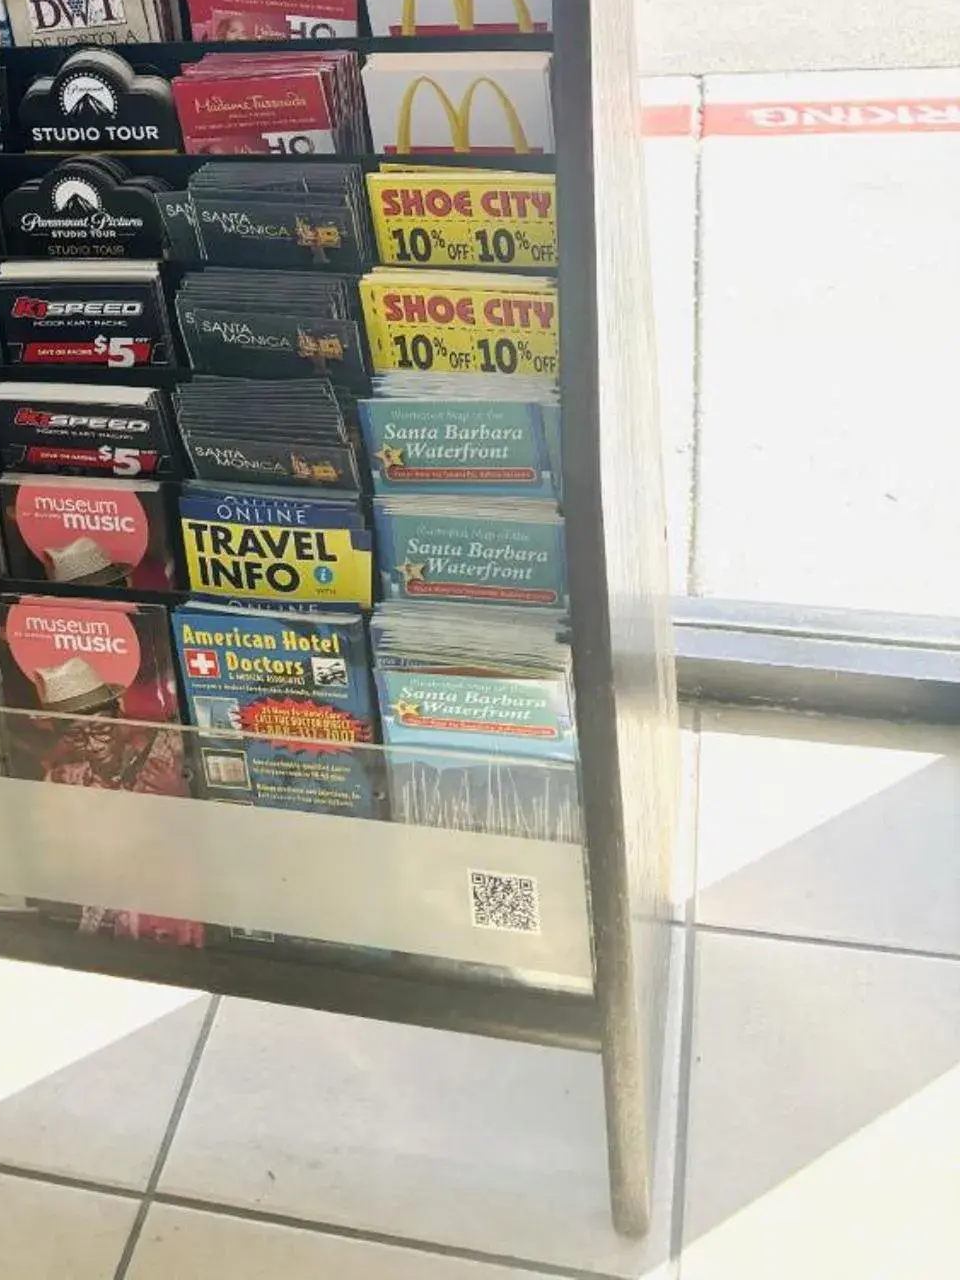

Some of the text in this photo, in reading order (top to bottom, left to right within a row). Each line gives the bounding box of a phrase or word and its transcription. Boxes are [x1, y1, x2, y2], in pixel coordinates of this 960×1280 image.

[32, 125, 159, 142] STUDIO TOUR
[381, 189, 552, 218] SHOE CITY
[21, 211, 143, 231] Paramount Pictures
[202, 211, 251, 224] SANTA
[222, 222, 290, 237] MONICA
[392, 228, 554, 263] 10% OFF 10% OFF
[48, 301, 143, 317] SPEED
[382, 293, 554, 329] SHOE CITY
[202, 322, 252, 334] SANTA
[384, 423, 523, 441] Santa Barbara
[98, 445, 142, 475] $5
[406, 442, 510, 462] Waterfront
[34, 496, 118, 514] museum
[216, 504, 307, 525] ONLINE
[62, 511, 136, 533] music
[187, 522, 338, 562] TRAVEL
[200, 557, 300, 593] INFO
[25, 617, 110, 635] museum
[53, 632, 128, 654] music
[182, 624, 340, 654] American Hotel
[225, 651, 304, 676] Doctors
